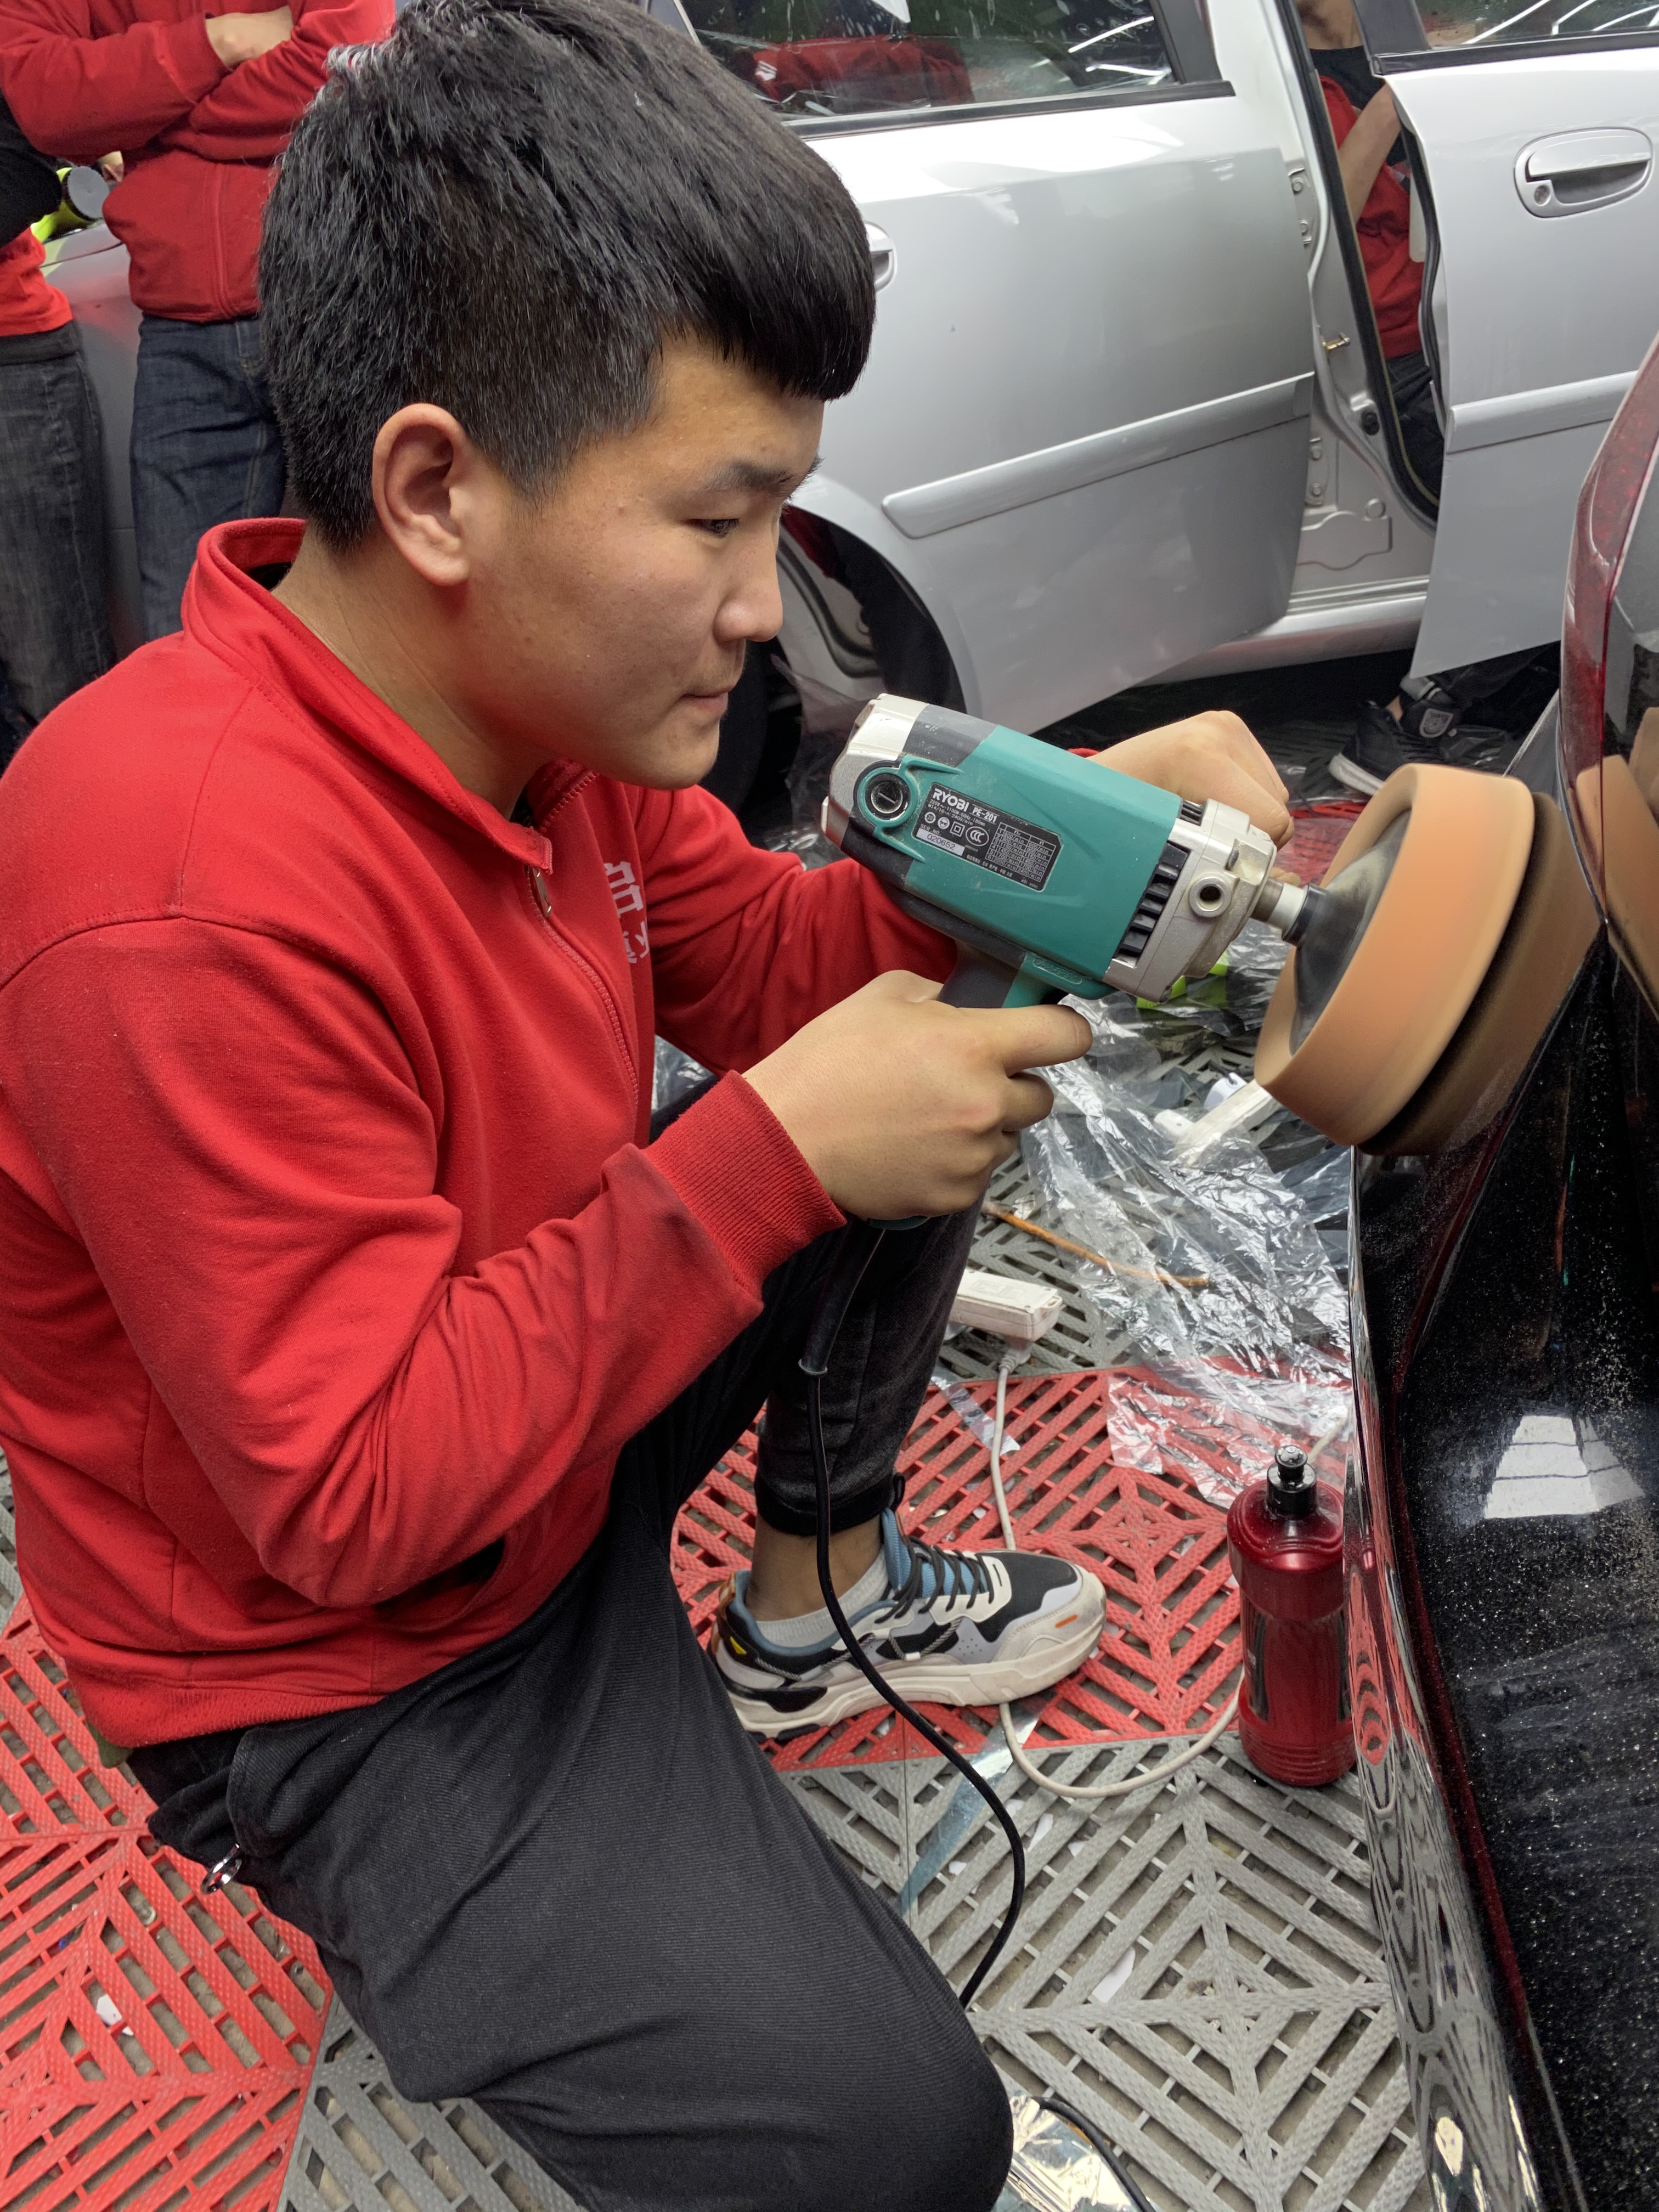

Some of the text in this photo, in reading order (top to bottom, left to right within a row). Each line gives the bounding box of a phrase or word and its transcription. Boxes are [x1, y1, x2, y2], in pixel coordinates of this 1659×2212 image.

[932, 788, 997, 823] RYOBI PE-201
[927, 833, 956, 850] 020652
